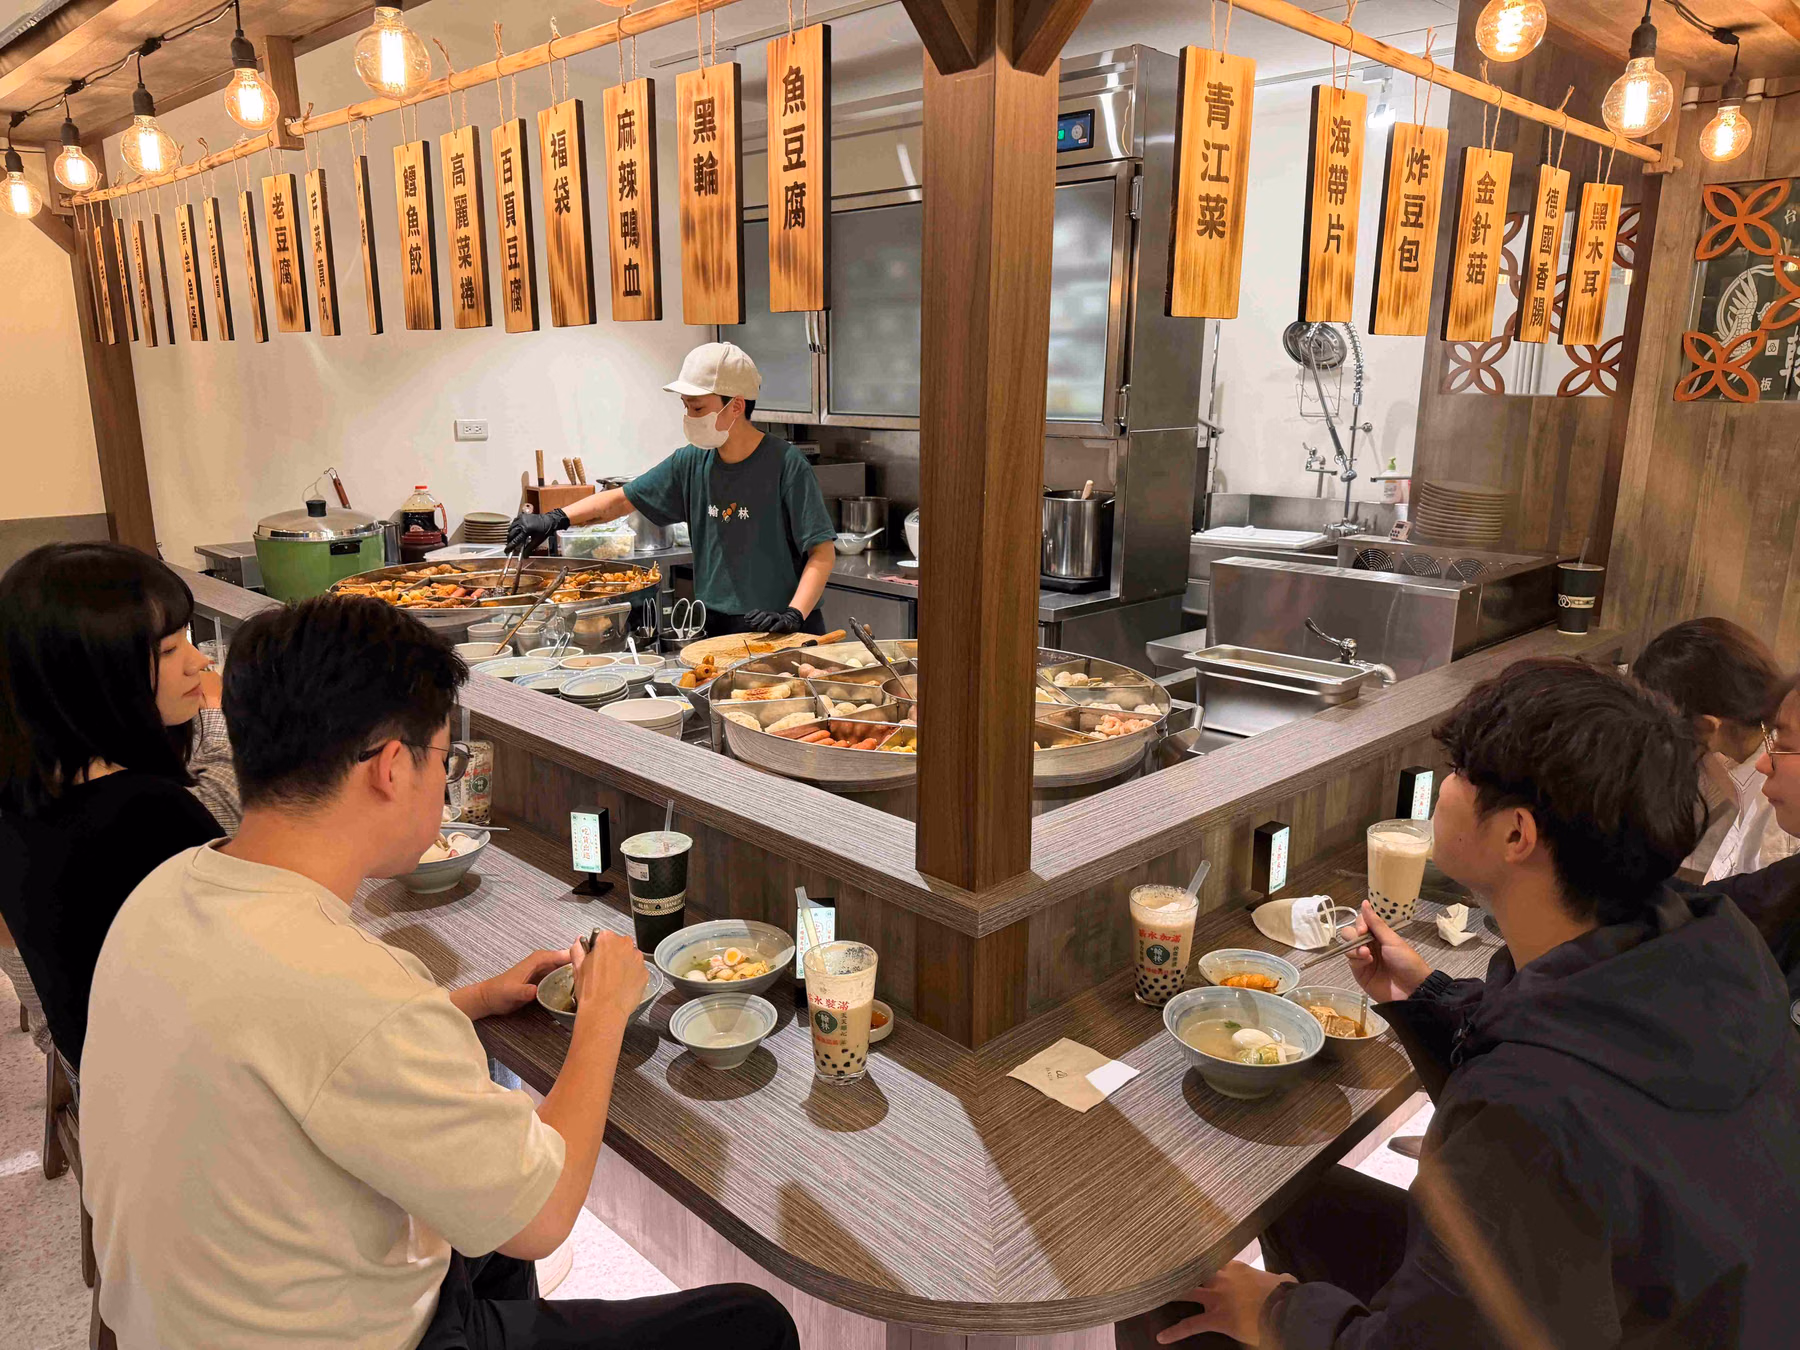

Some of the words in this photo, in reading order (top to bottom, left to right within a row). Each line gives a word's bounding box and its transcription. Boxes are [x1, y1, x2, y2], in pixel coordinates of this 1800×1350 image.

[550, 129, 571, 216] 福袋
[616, 108, 642, 298] 麻辣鴨血
[692, 96, 719, 197] 黑輪
[781, 65, 807, 231] 魚豆腐
[1196, 81, 1235, 240] 青江菜
[1323, 115, 1352, 255] 海帶片
[1397, 146, 1431, 273] 炸豆包
[271, 192, 293, 285] 老豆腐
[450, 152, 475, 311] 高麗菜捲
[500, 146, 523, 313] 百頁豆腐
[1465, 171, 1497, 286] 金針菇
[1529, 187, 1560, 327] 德國香腸
[1581, 201, 1609, 298] 黑木耳
